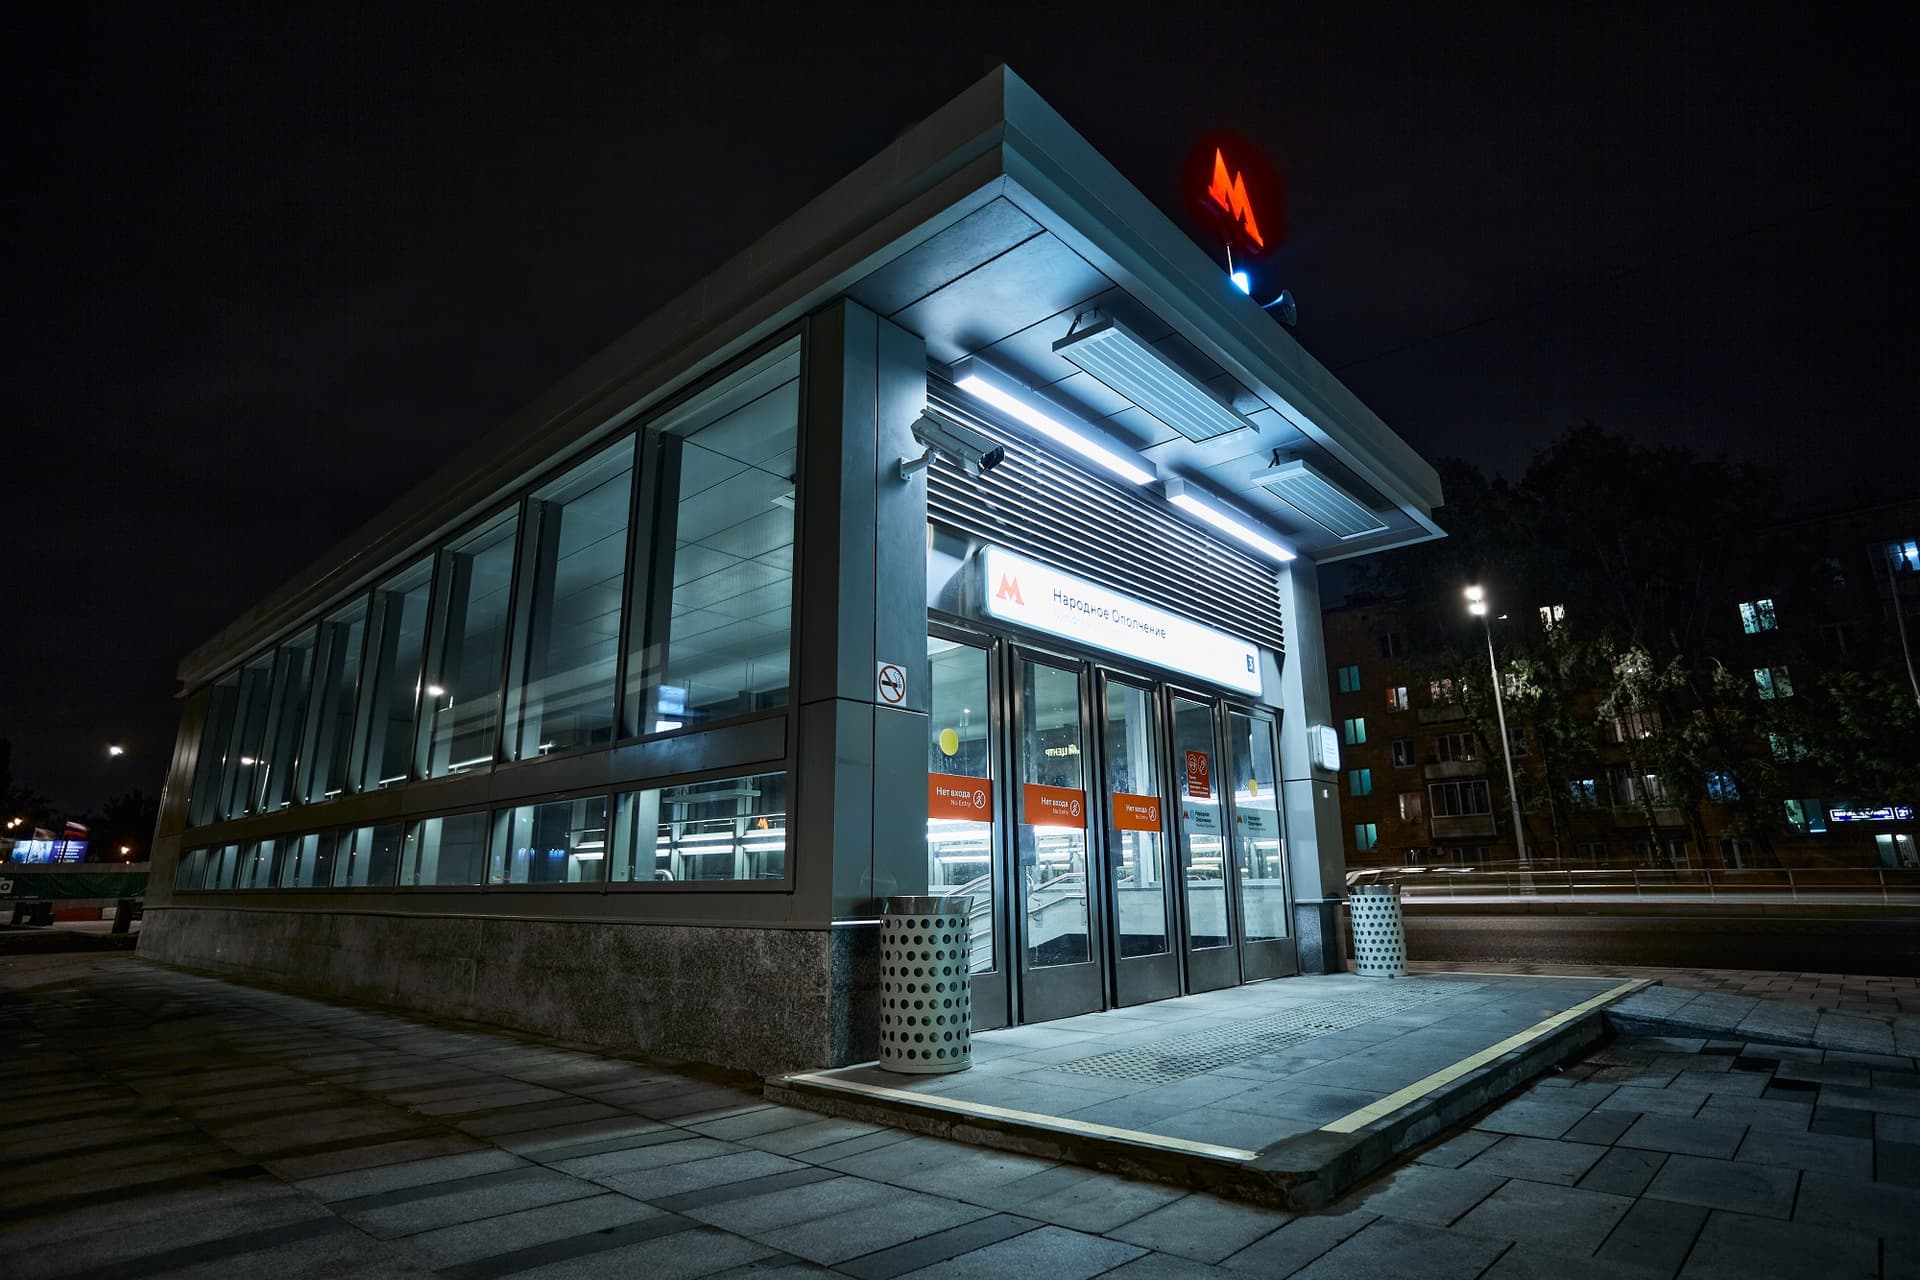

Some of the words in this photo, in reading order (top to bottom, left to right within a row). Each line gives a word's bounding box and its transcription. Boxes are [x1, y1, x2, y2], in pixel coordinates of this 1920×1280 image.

[1053, 588, 1109, 620] Народное
[1111, 609, 1167, 639] Ополчение
[936, 786, 949, 796] Нет
[950, 789, 971, 799] входа
